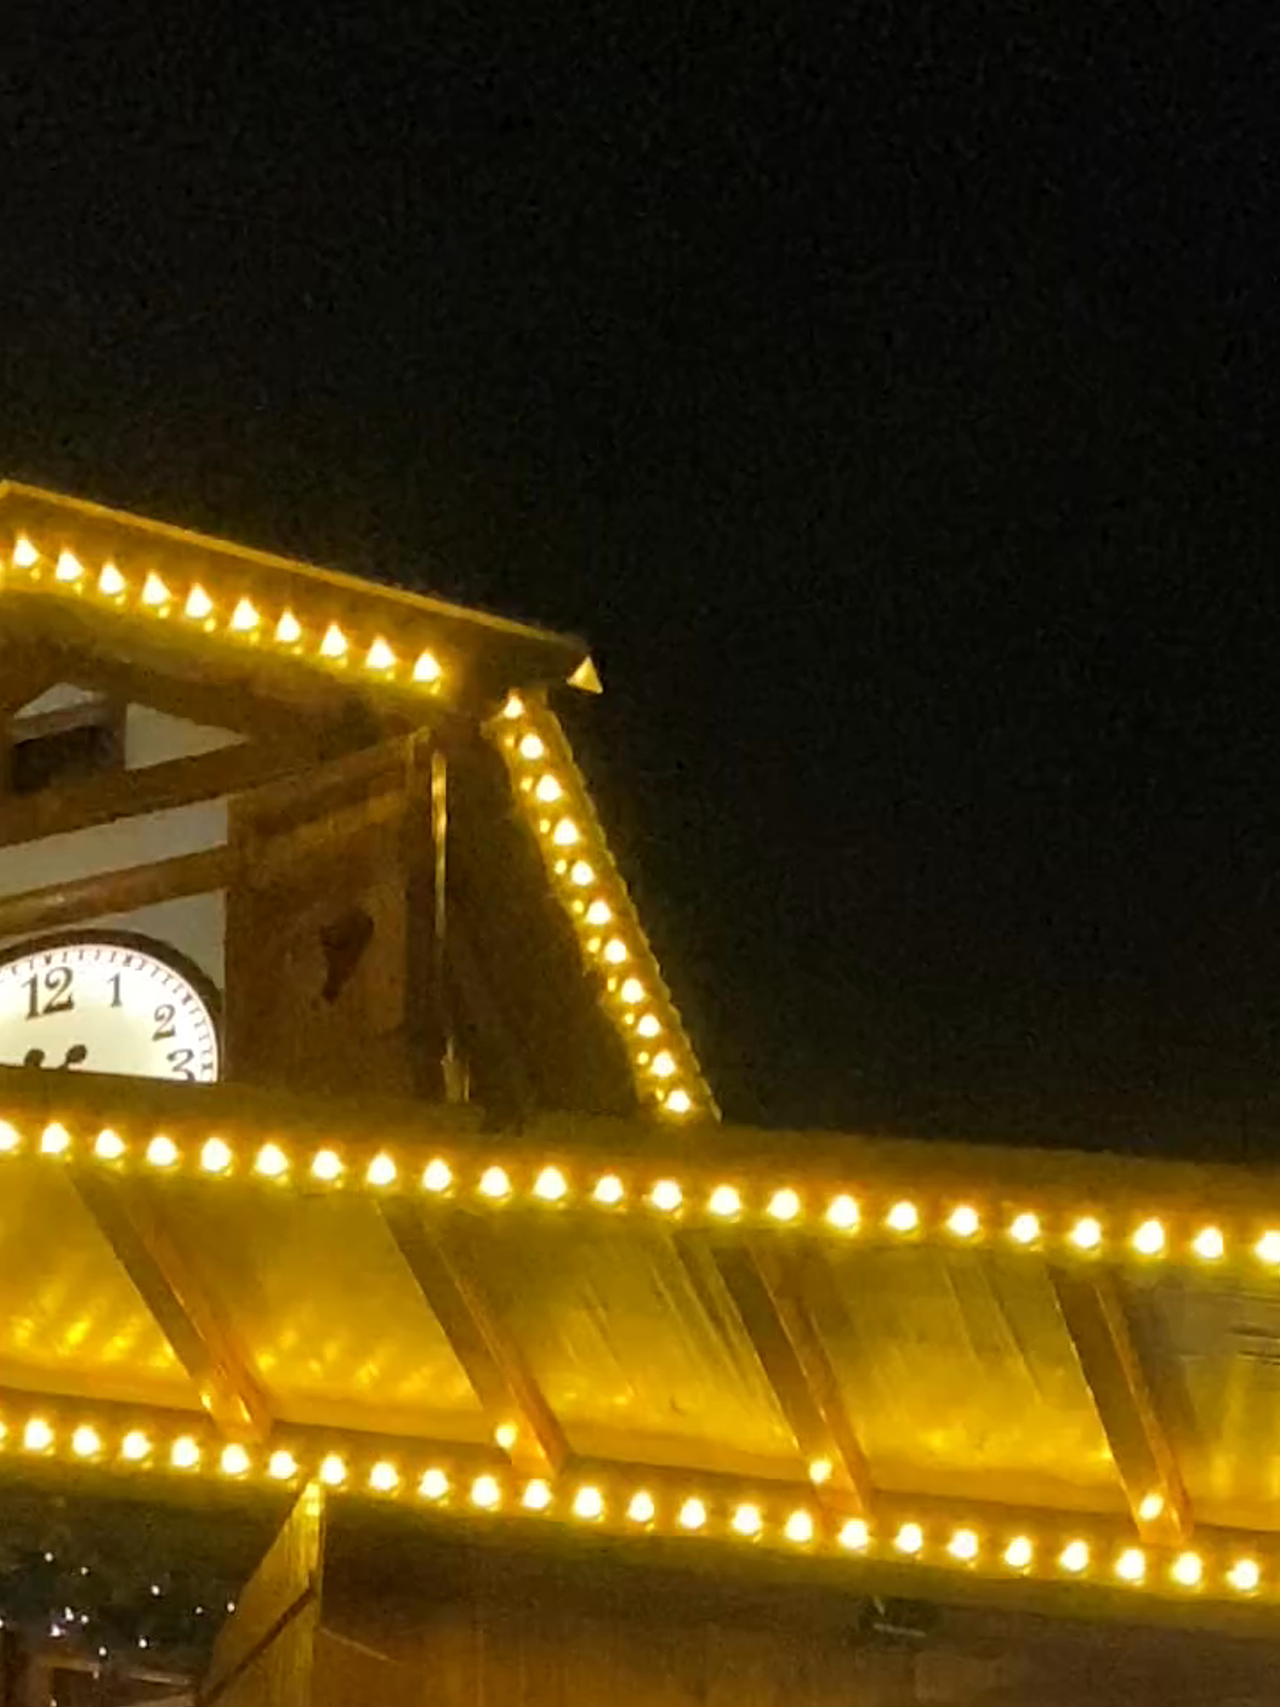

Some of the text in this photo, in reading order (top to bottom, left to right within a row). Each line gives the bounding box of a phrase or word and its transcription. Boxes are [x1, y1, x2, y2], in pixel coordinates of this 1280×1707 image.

[21, 966, 74, 1020] 12
[107, 972, 122, 1008] 1
[152, 1004, 176, 1042] 2
